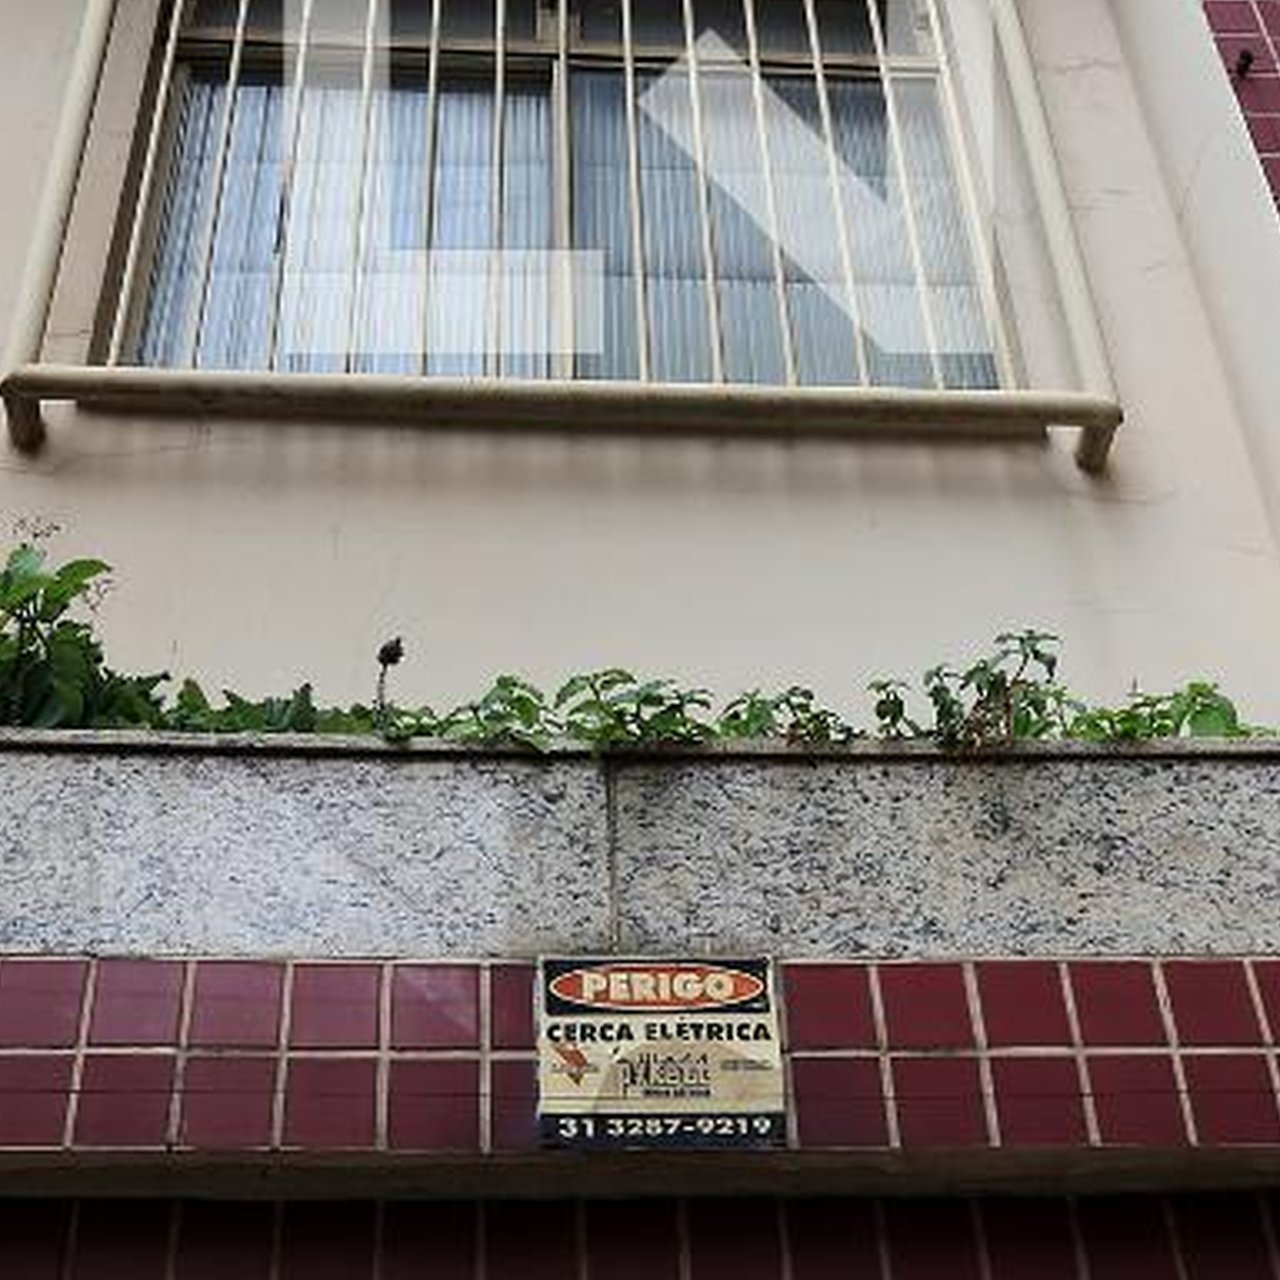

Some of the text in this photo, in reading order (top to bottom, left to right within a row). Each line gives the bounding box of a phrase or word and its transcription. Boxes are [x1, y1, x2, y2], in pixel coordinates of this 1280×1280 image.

[581, 971, 735, 1002] PERIGO
[546, 1016, 772, 1042] CERCA ELÉTRICA
[558, 1118, 772, 1138] 31 3287-9219
